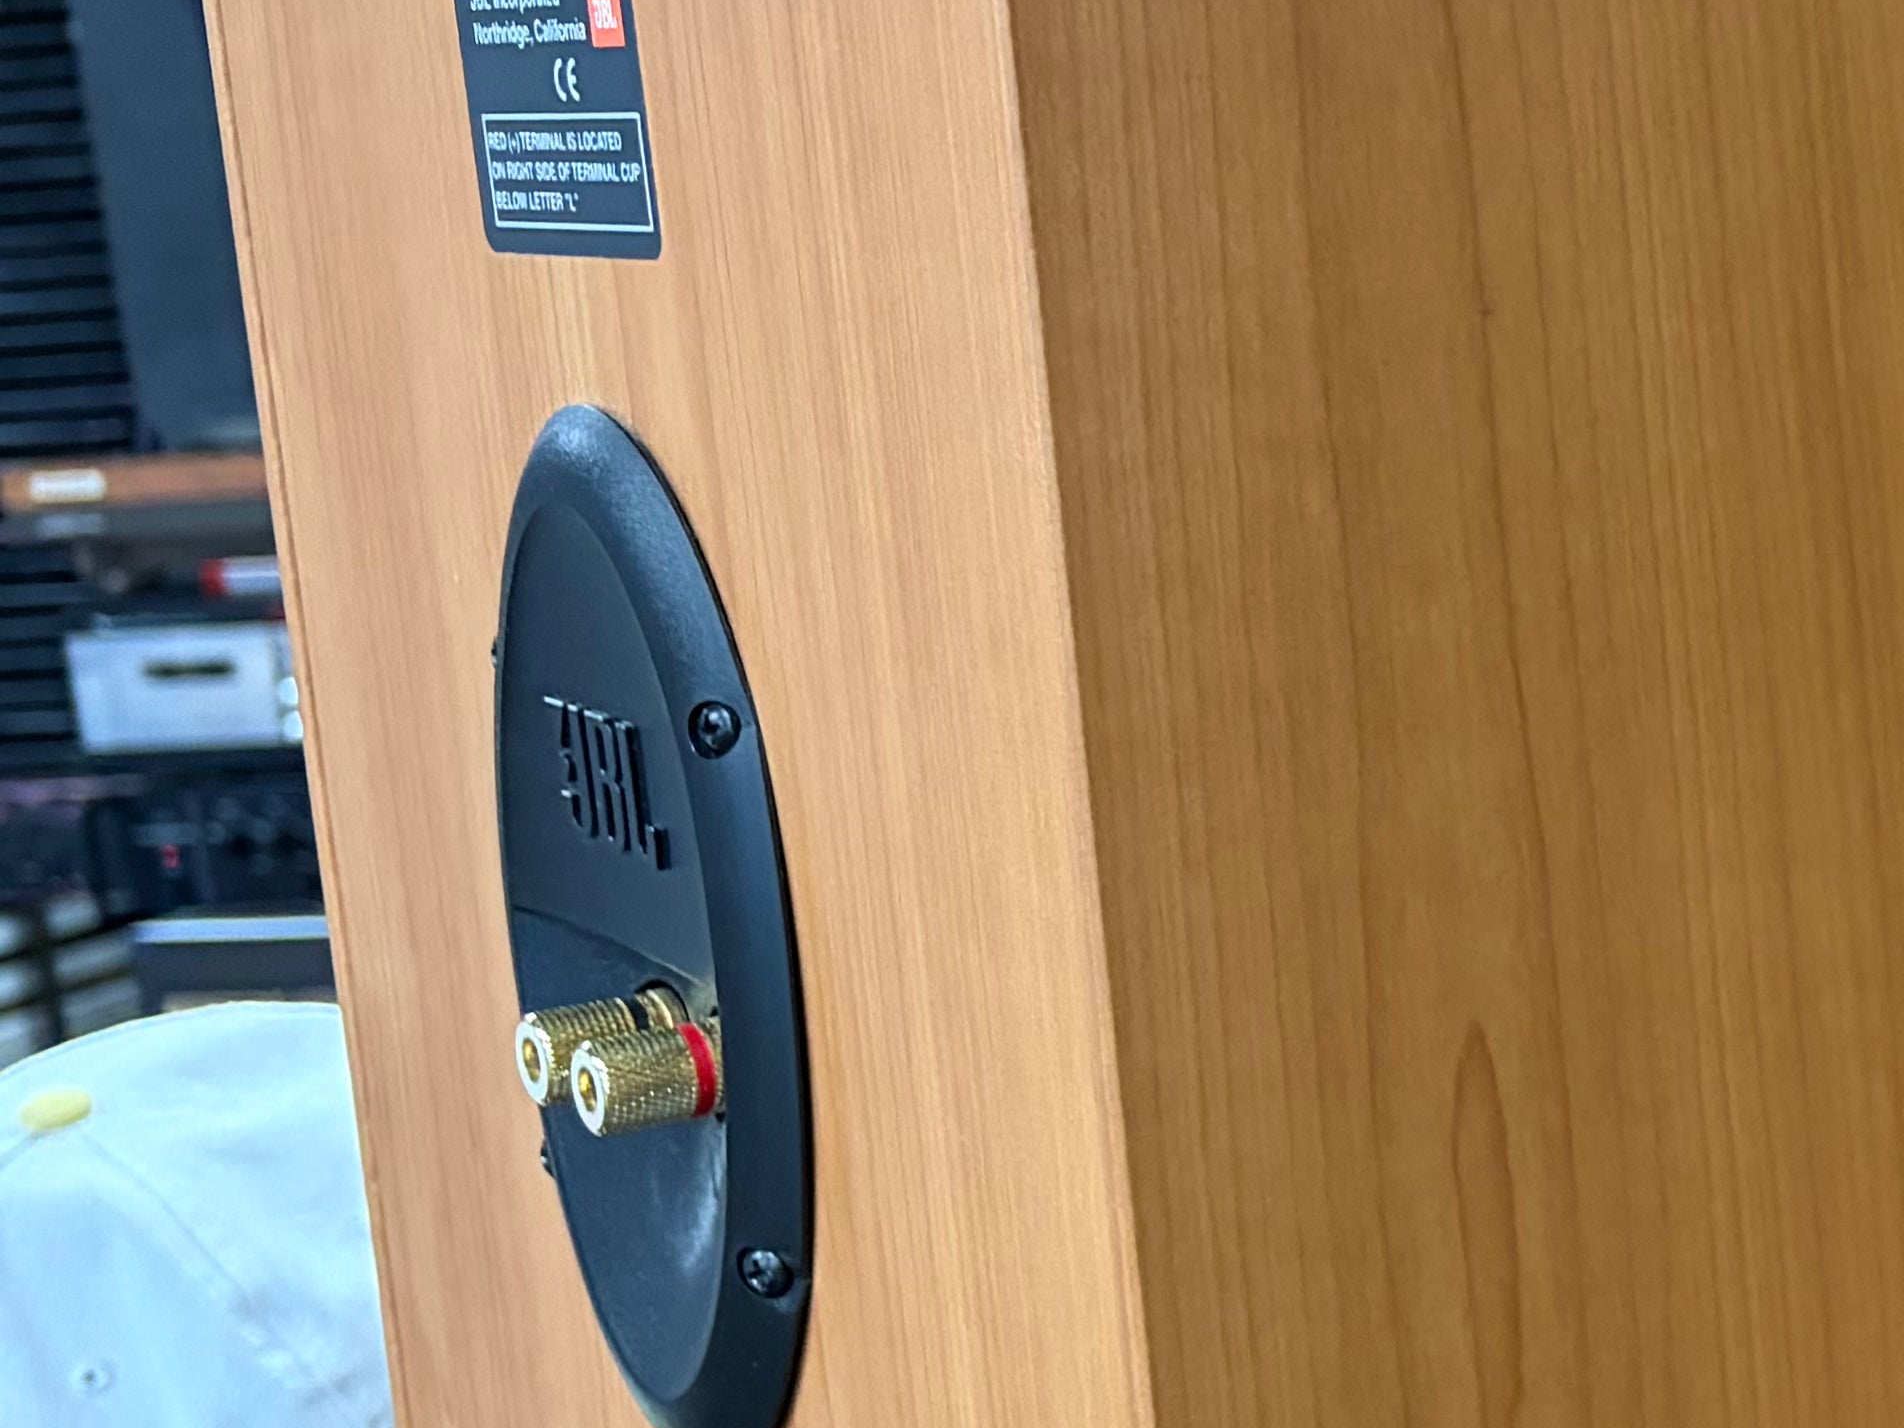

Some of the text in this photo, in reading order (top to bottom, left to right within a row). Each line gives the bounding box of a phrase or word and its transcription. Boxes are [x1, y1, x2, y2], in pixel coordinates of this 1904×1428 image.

[472, 17, 587, 49] Northridge, California
[553, 57, 580, 102] CE
[487, 131, 507, 151] RED
[519, 131, 566, 151] TERMINAL
[566, 130, 577, 151] IS
[577, 130, 622, 151] LOCATED
[492, 161, 641, 183] ON RIGHT SIDE OF TERMINAL CUP
[495, 190, 528, 210] BELOW
[528, 191, 564, 211] LETTER
[542, 695, 672, 872] JBL
